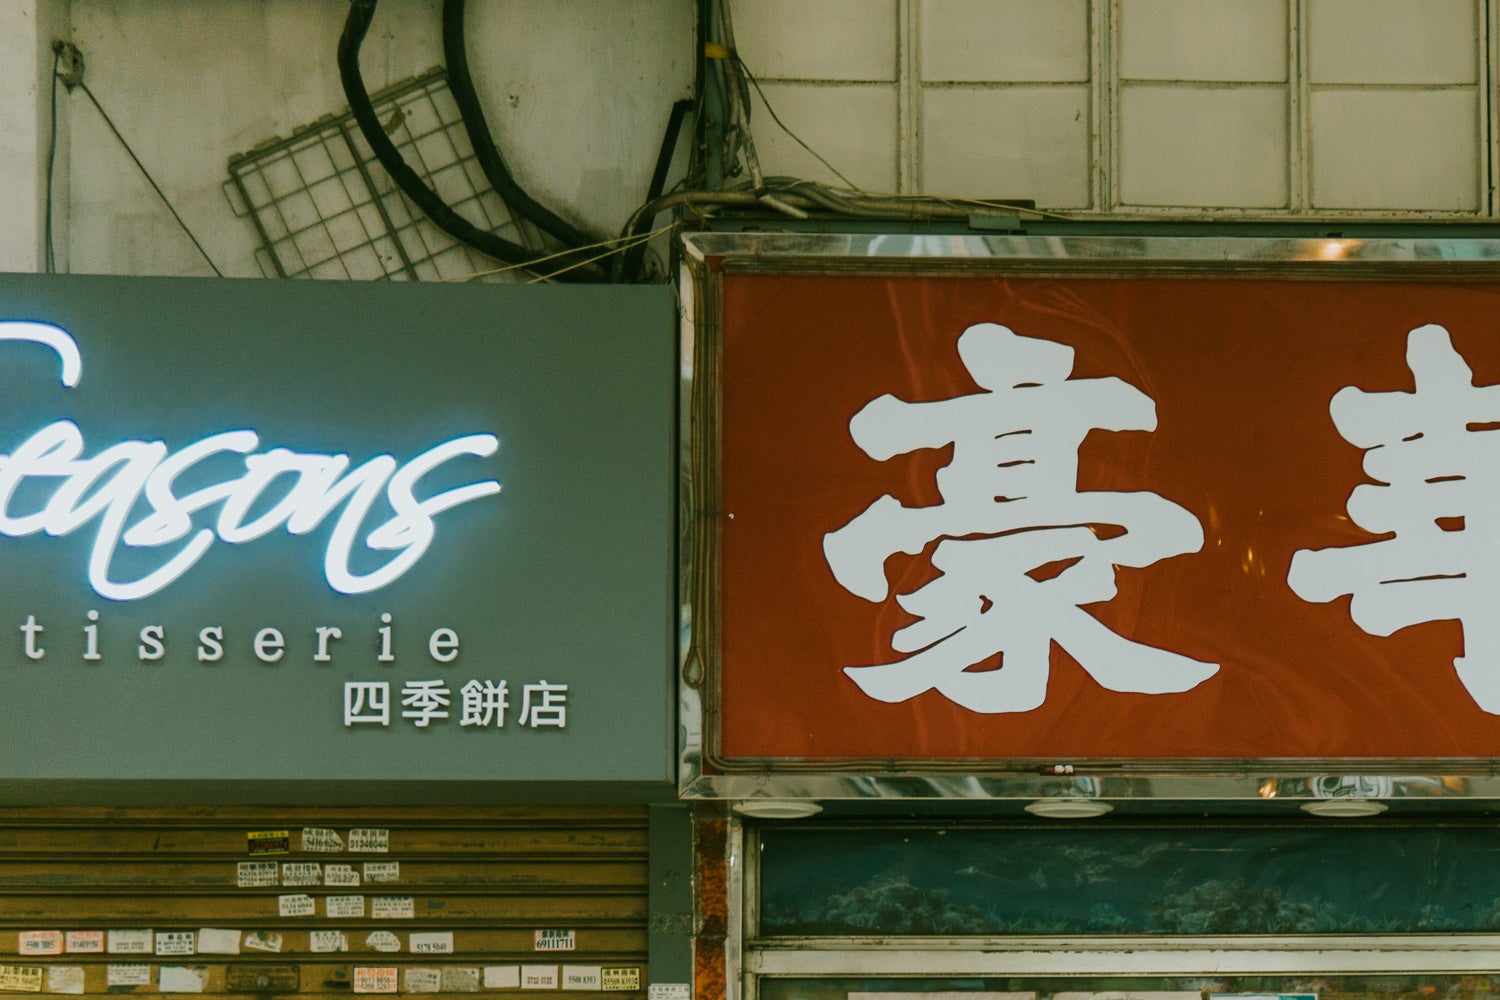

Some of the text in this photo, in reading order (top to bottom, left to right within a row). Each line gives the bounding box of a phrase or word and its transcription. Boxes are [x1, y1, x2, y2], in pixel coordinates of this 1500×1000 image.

[343, 679, 569, 728] 四季餅店
[536, 938, 574, 950] 69111711
